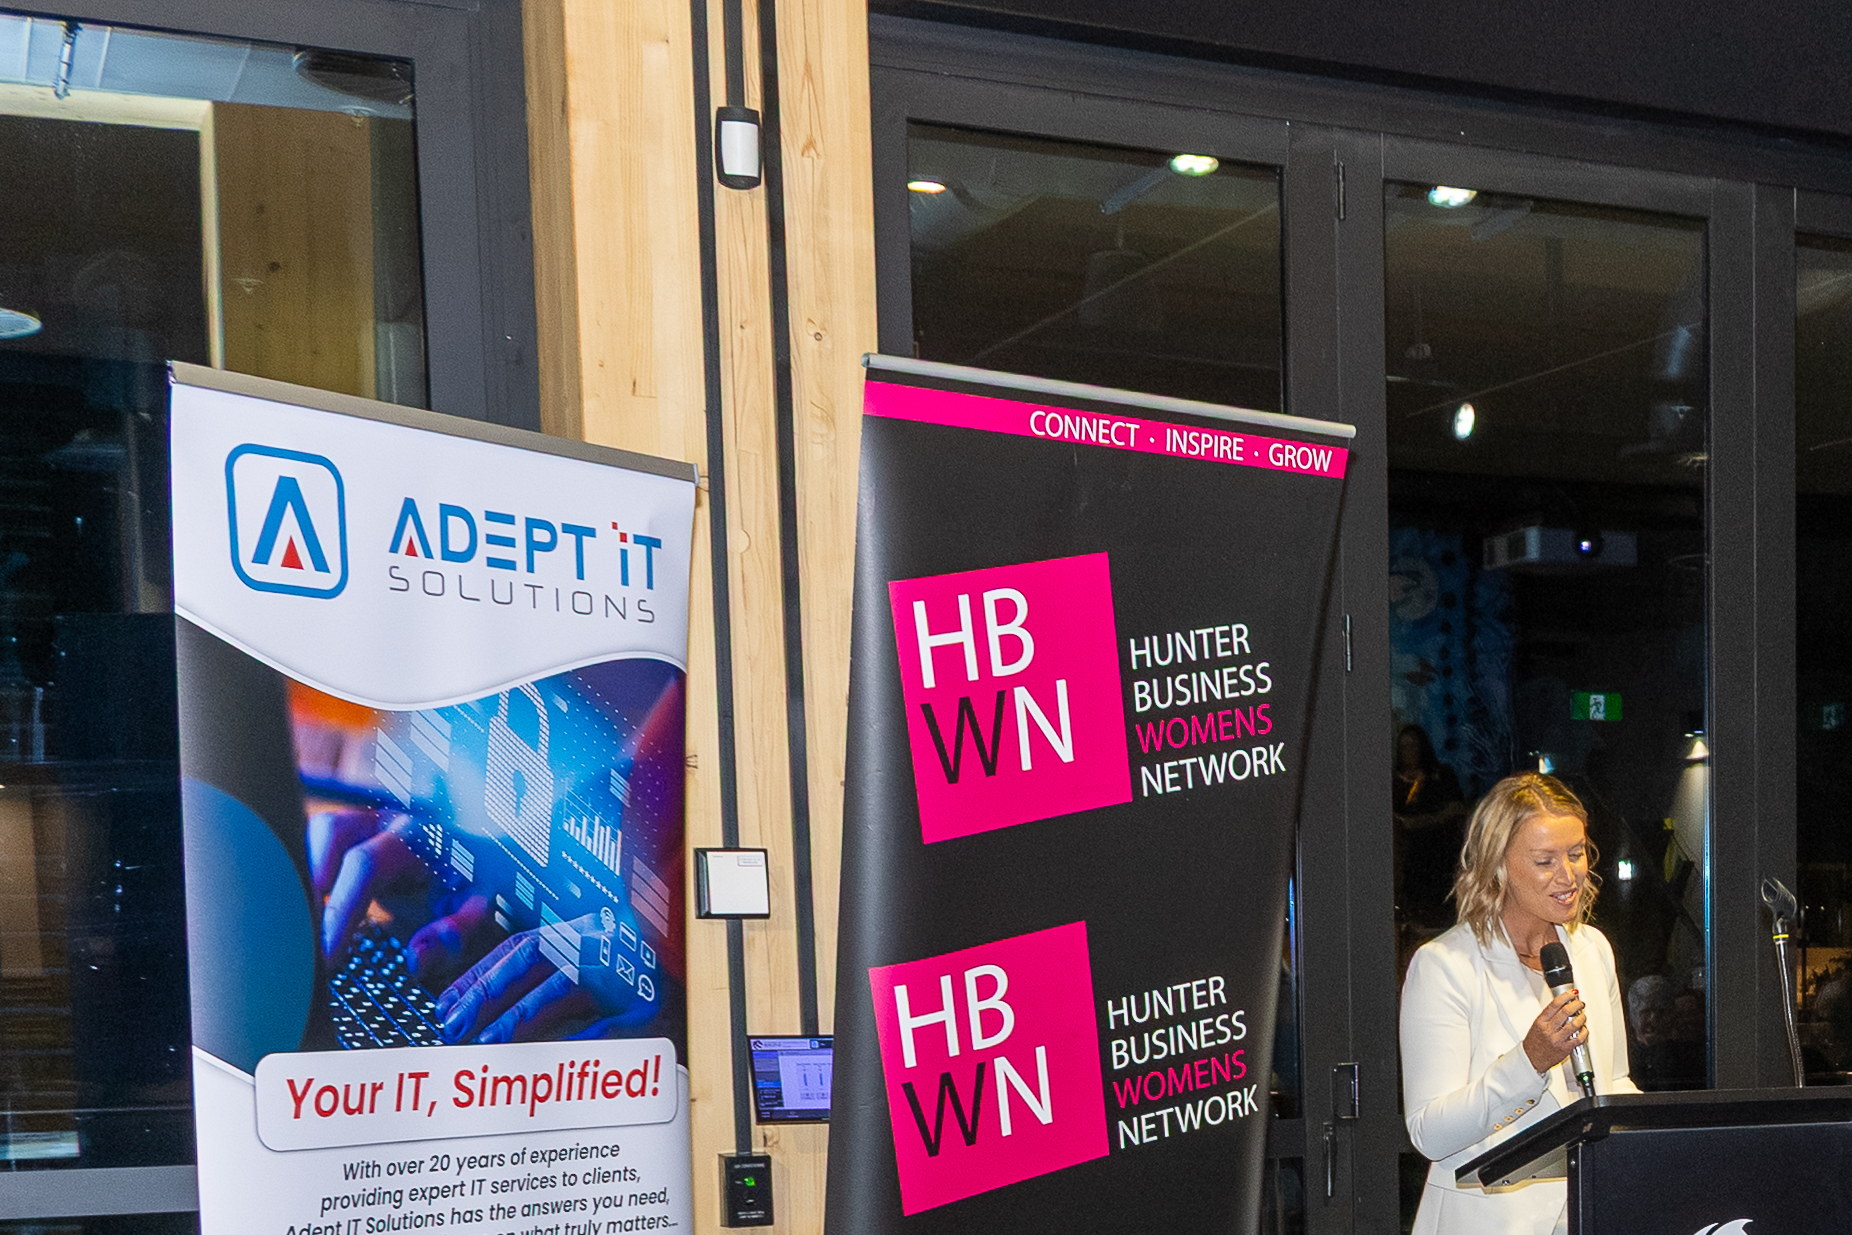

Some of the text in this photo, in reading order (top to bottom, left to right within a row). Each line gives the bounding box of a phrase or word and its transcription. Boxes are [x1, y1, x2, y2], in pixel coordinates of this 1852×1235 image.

[1029, 410, 1332, 472] CONNECT INSPIRE GROW
[389, 497, 596, 580] ADEPT
[389, 565, 655, 623] SOLUTIONS
[912, 587, 1036, 690] HB
[1129, 623, 1251, 670] HUNTER
[1133, 663, 1272, 713] BUSINESS
[920, 679, 1074, 785] WN
[1135, 704, 1273, 754] WOMENS
[1140, 742, 1286, 798] NETWORK
[894, 964, 1015, 1068] HB
[1107, 976, 1227, 1029] HUNTER
[1111, 1010, 1247, 1070] BUSINESS
[286, 1055, 661, 1119] Your IT, Simplified!
[901, 1045, 1053, 1159] WN
[1113, 1050, 1247, 1108] WOMENS
[1117, 1084, 1258, 1149] NETWORK
[320, 1164, 641, 1217] providing expert IT services to clients,
[342, 1142, 620, 1181] With over 20 years of experience
[366, 1212, 444, 1235] Solutions
[450, 1206, 483, 1225] has
[489, 1203, 516, 1221] the
[521, 1197, 587, 1218] answers
[593, 1195, 622, 1215] you
[628, 1187, 669, 1206] need,
